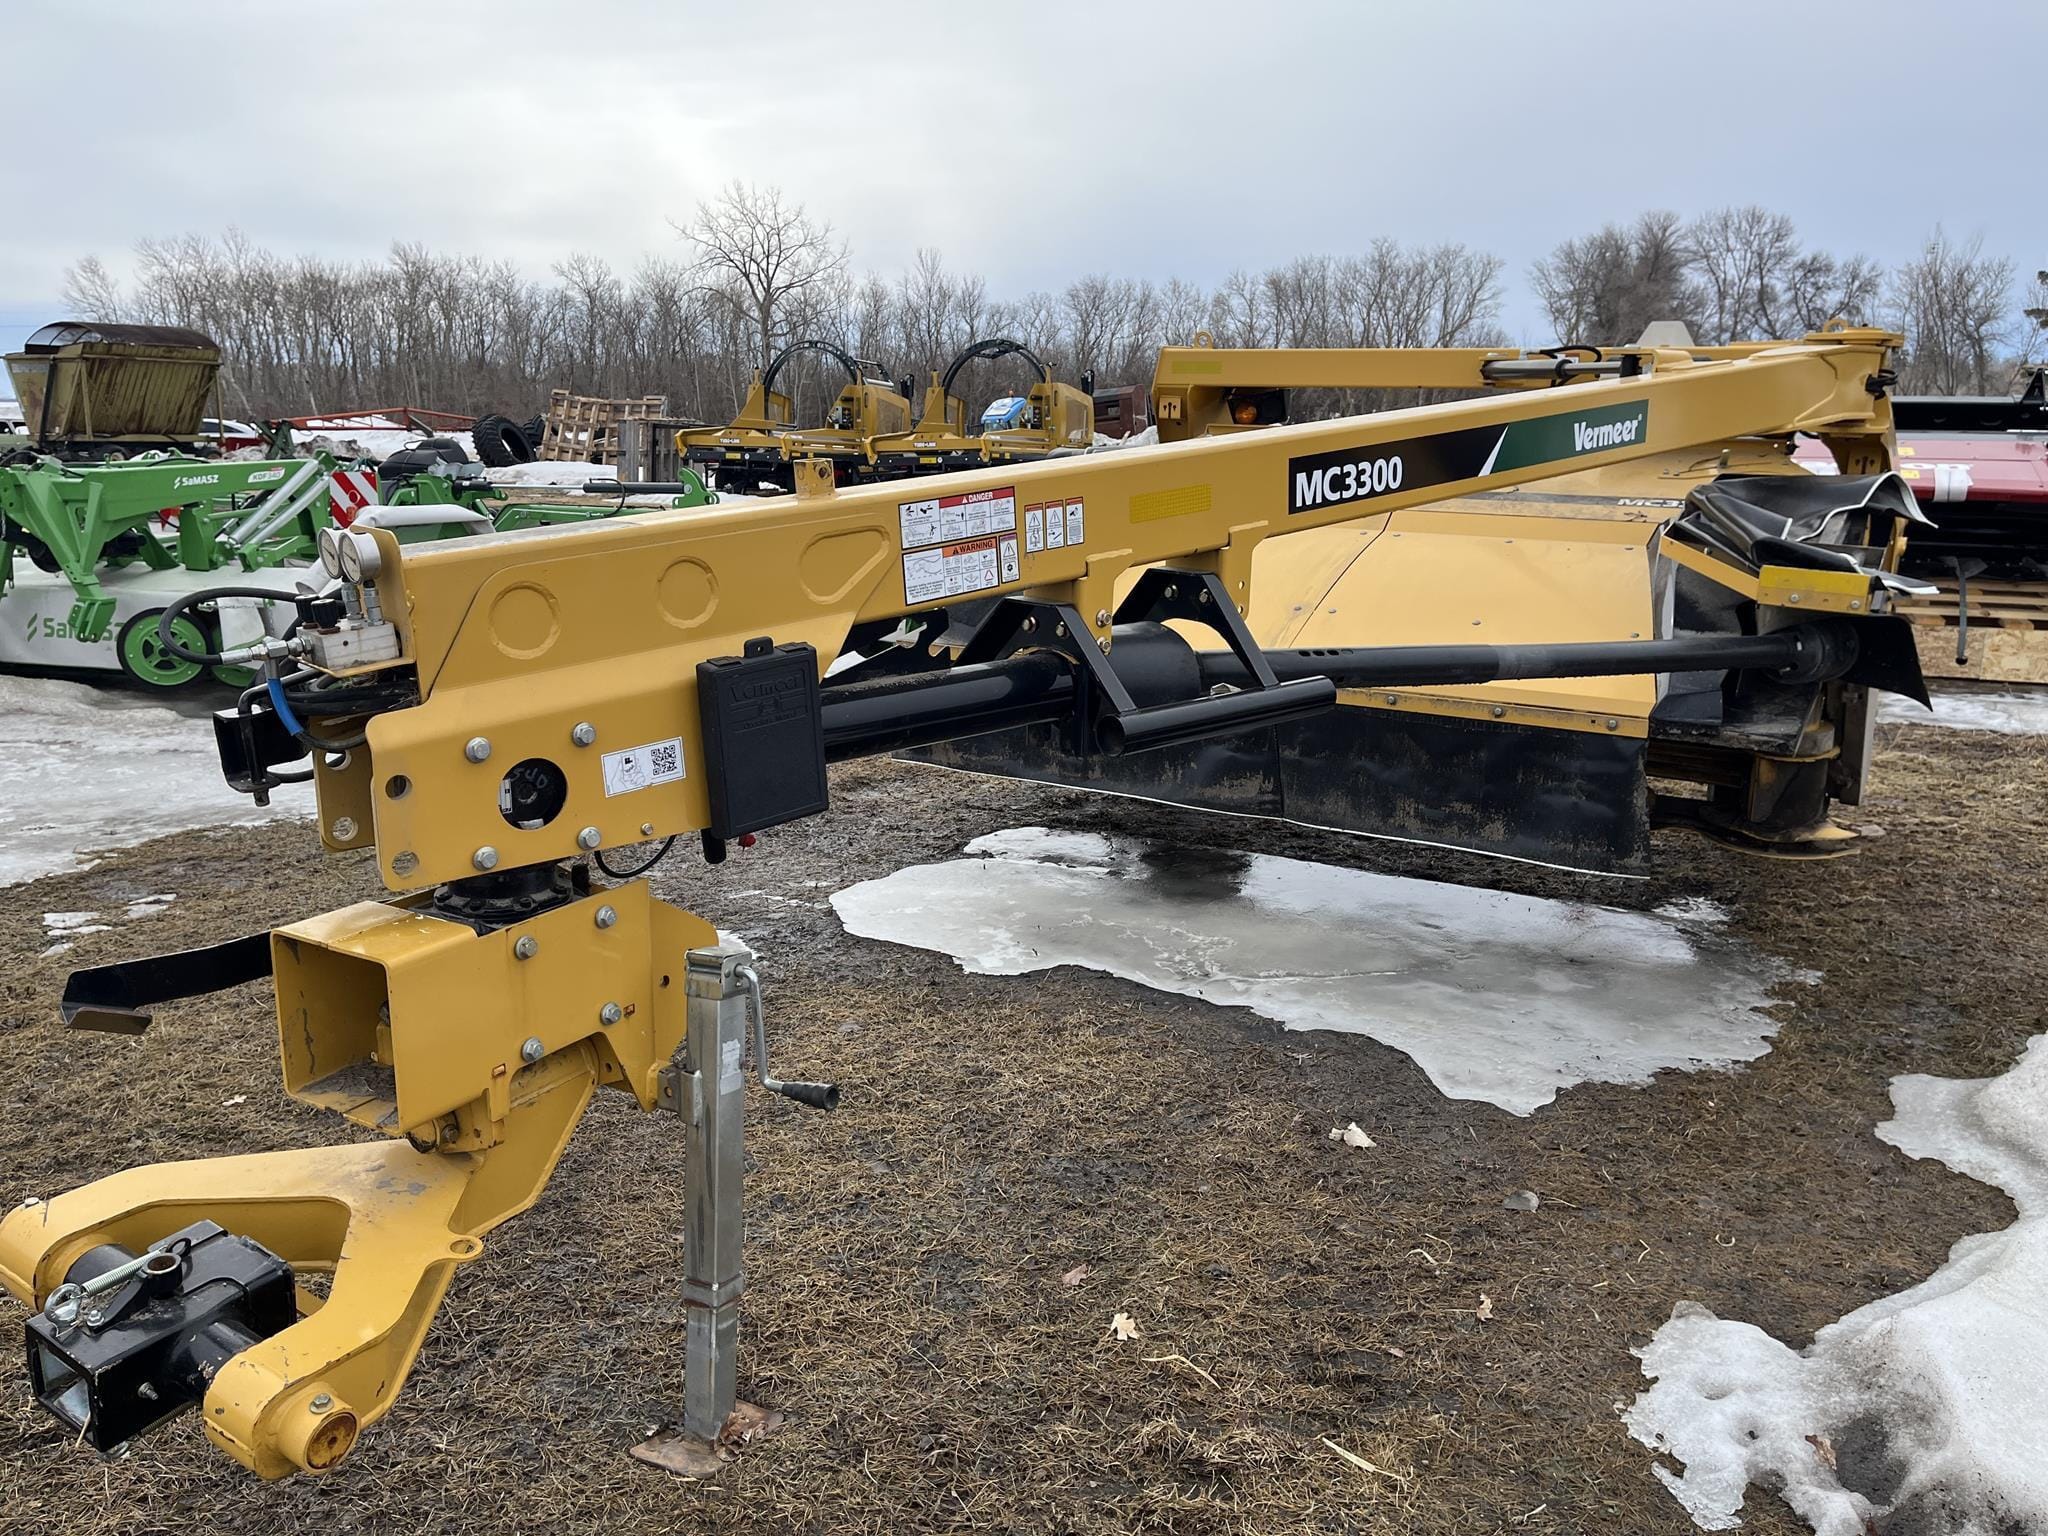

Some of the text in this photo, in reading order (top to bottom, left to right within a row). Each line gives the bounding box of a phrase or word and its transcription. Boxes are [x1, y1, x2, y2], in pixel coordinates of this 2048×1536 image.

[1574, 419, 1639, 452] Vermeer
[181, 474, 220, 487] SaMASZ
[1295, 455, 1403, 508] MC3300
[968, 491, 994, 503] DANGER
[959, 540, 993, 553] WARNING
